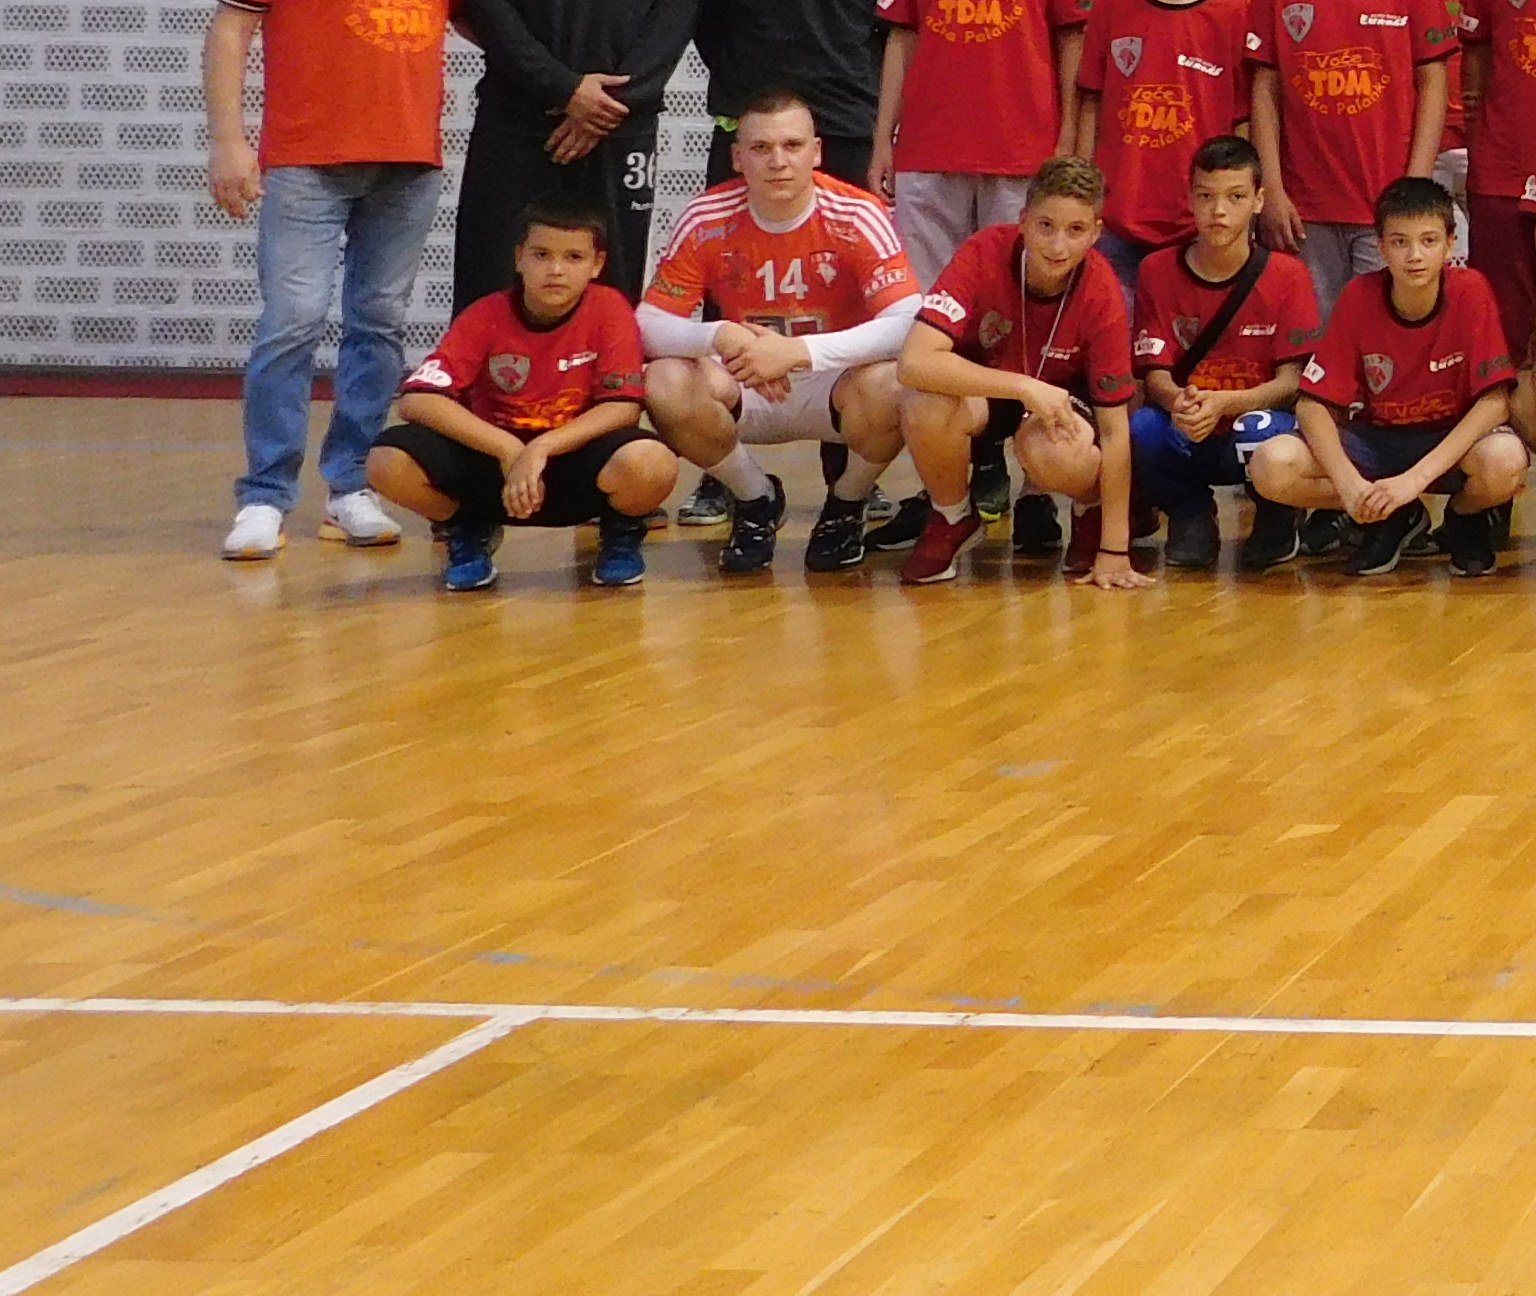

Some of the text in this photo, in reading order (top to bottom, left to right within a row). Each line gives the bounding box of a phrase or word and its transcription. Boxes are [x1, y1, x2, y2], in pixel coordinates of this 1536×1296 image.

[938, 0, 1002, 25] TDM
[1308, 70, 1373, 97] TDM
[756, 259, 808, 302] 14
